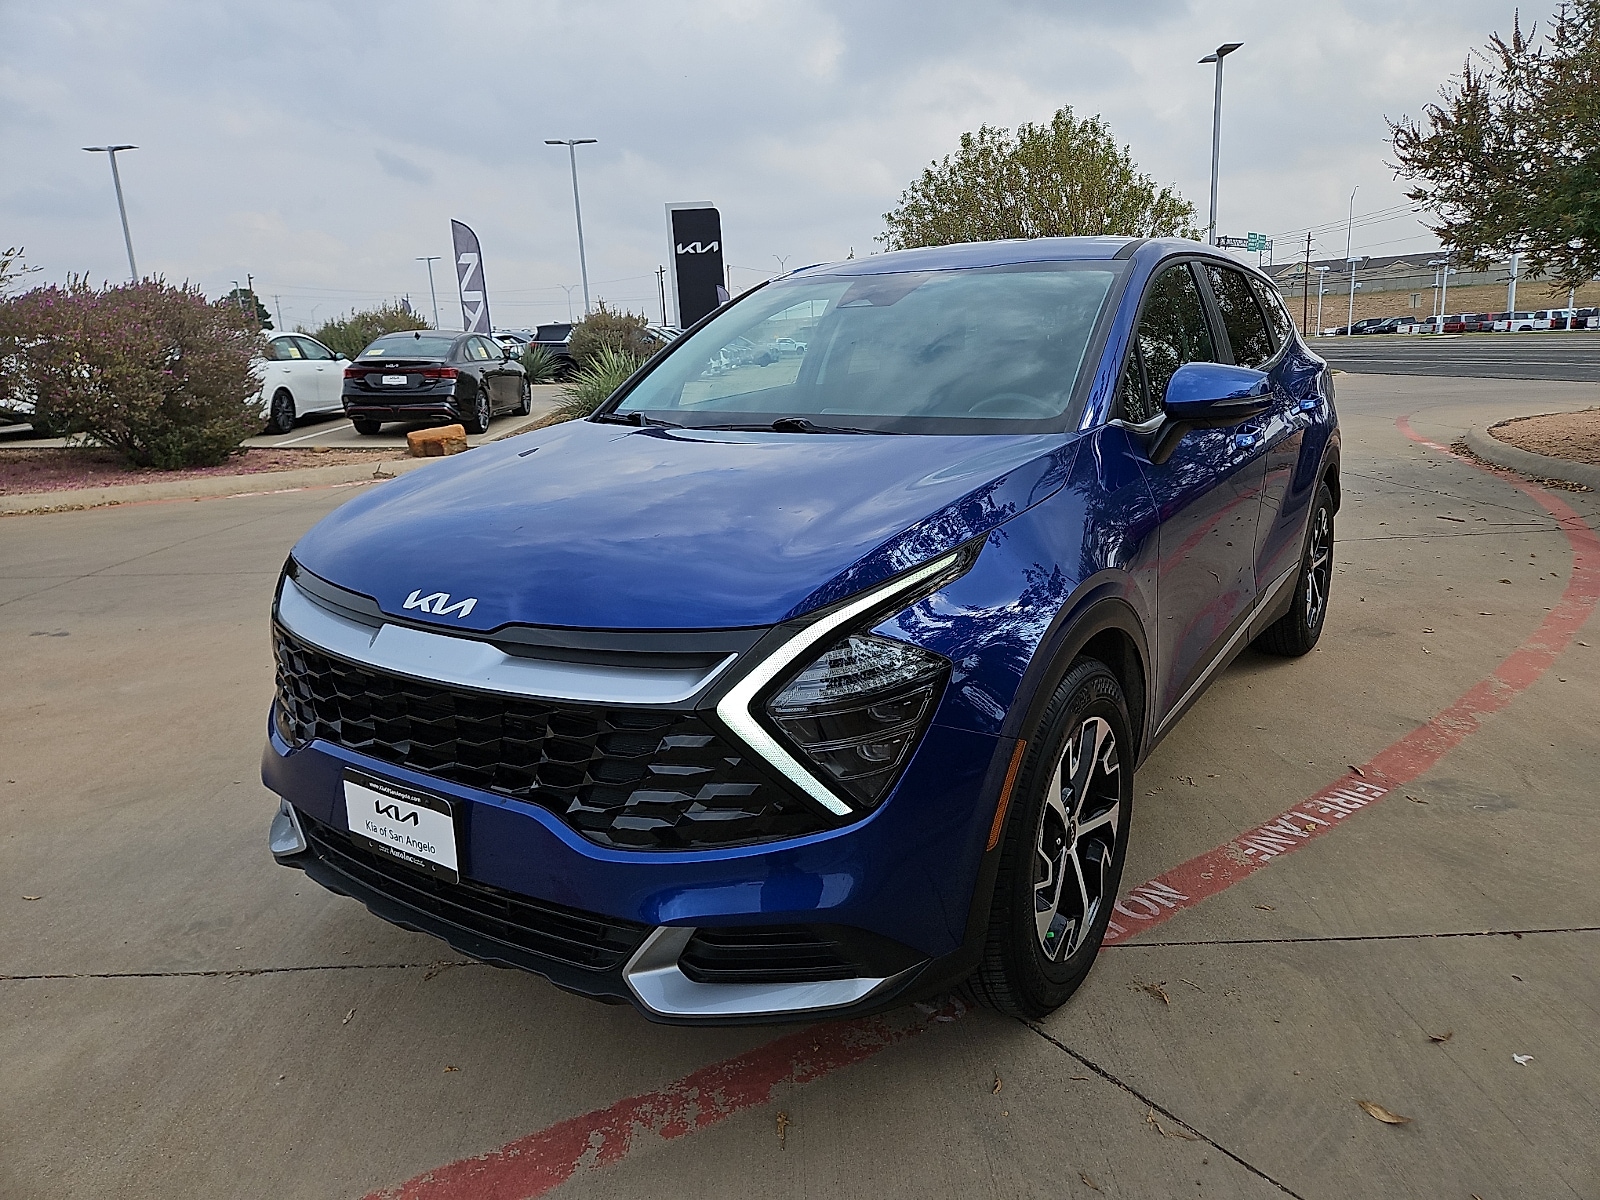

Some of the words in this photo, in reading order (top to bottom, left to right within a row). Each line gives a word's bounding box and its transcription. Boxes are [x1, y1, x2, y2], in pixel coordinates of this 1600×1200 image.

[677, 241, 719, 254] KIA
[403, 589, 478, 618] KIA
[375, 800, 419, 826] KIA
[1303, 780, 1389, 819] FIRE
[365, 820, 378, 833] Kia
[379, 826, 387, 837] of
[388, 829, 404, 843] San
[405, 835, 436, 854] Angelo
[1239, 811, 1332, 861] LANE
[1114, 881, 1190, 919] NO
